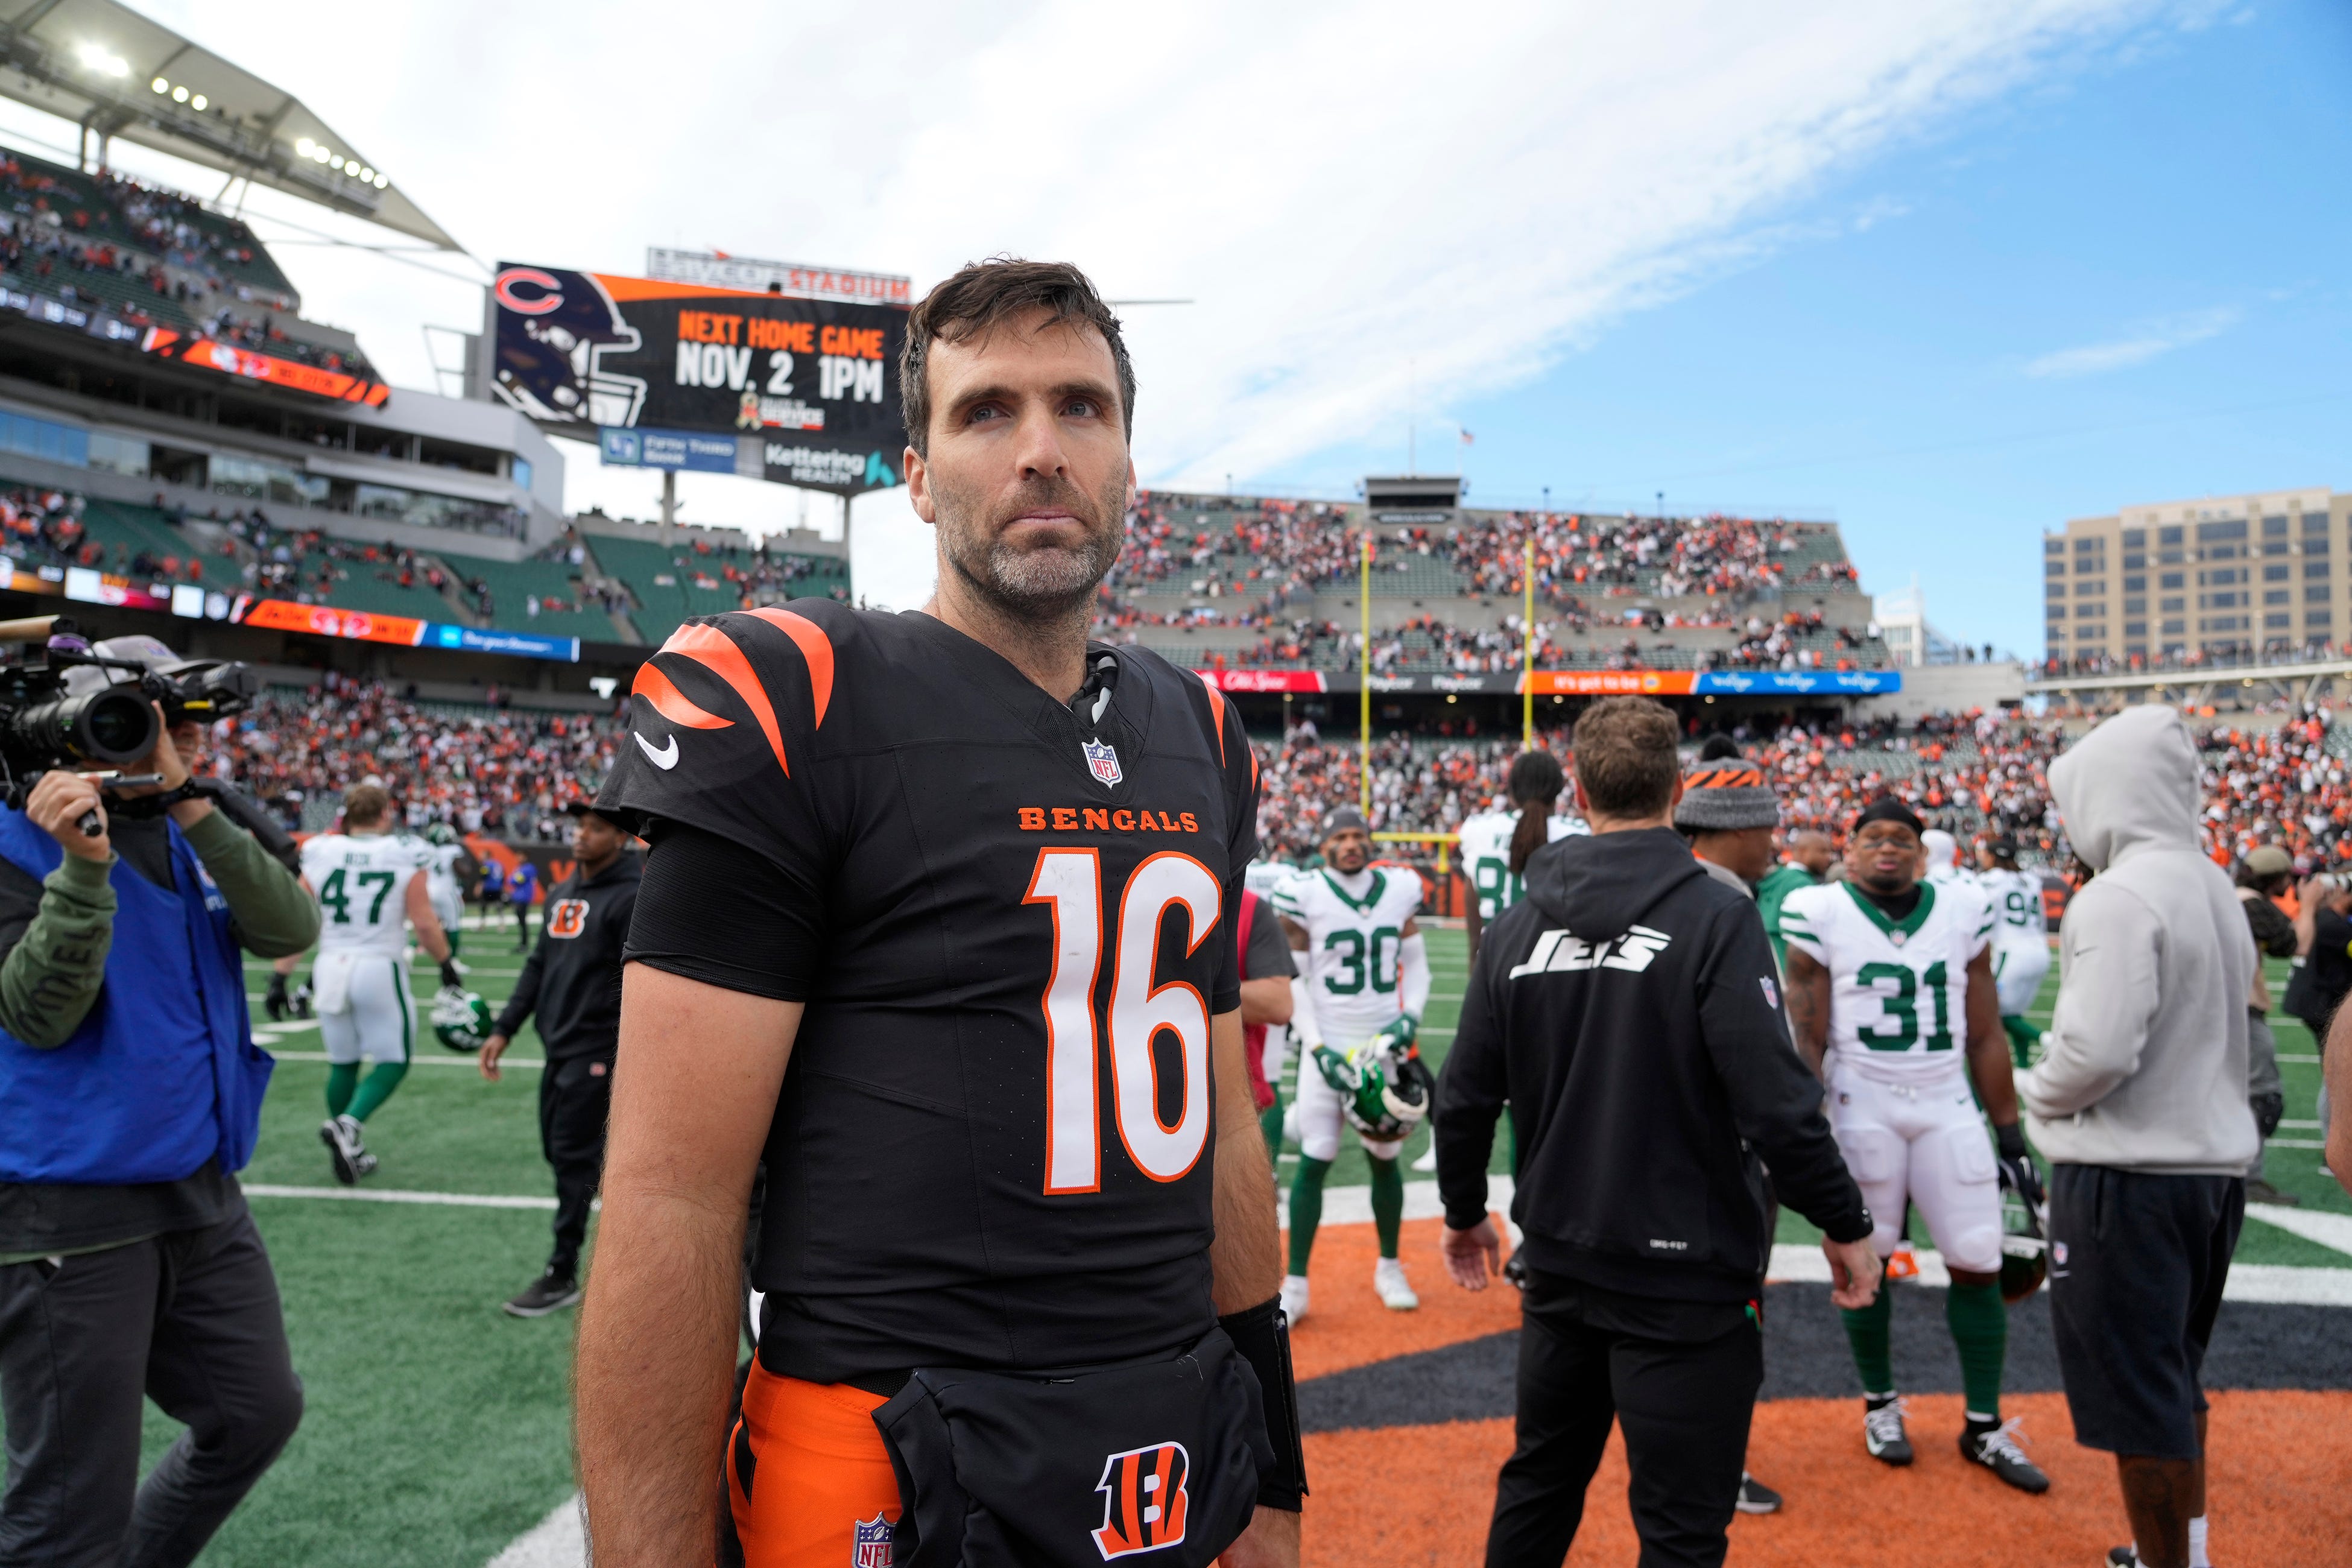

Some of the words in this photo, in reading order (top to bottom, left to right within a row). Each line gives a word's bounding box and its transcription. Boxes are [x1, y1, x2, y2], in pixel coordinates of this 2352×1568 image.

[789, 270, 909, 299] STADIUM
[678, 309, 743, 346] NEXT
[747, 317, 815, 353] HOME
[820, 326, 884, 359] GAME
[675, 341, 756, 391] NOV.
[767, 350, 794, 395] 2
[818, 355, 884, 403] 1PM
[766, 443, 865, 476] Kettering
[1093, 759, 1118, 779] NFL
[1017, 808, 1199, 833] BENGALS
[321, 868, 394, 923] 47
[1325, 926, 1401, 994] 30
[1020, 847, 1222, 1195] 16
[1857, 960, 1953, 1052] 31
[859, 1544, 893, 1568] NFL
